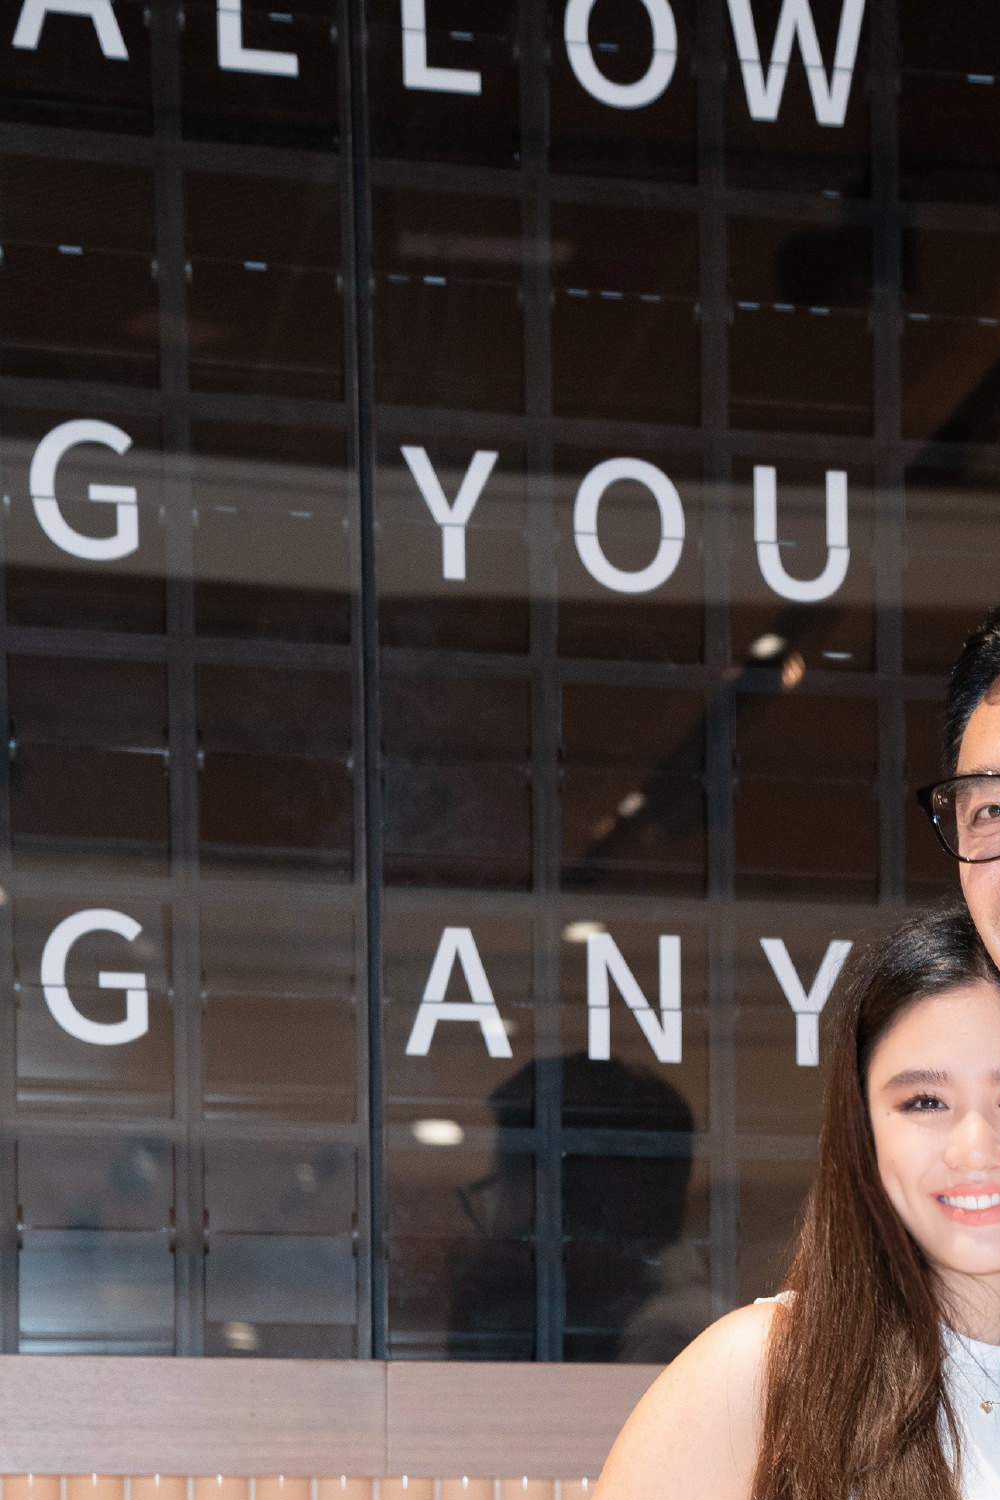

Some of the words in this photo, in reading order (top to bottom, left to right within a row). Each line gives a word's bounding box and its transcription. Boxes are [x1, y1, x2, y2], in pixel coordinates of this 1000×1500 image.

[29, 418, 139, 561] G
[401, 446, 851, 603] YOU
[40, 908, 149, 1046] G
[405, 926, 854, 1067] ANY
